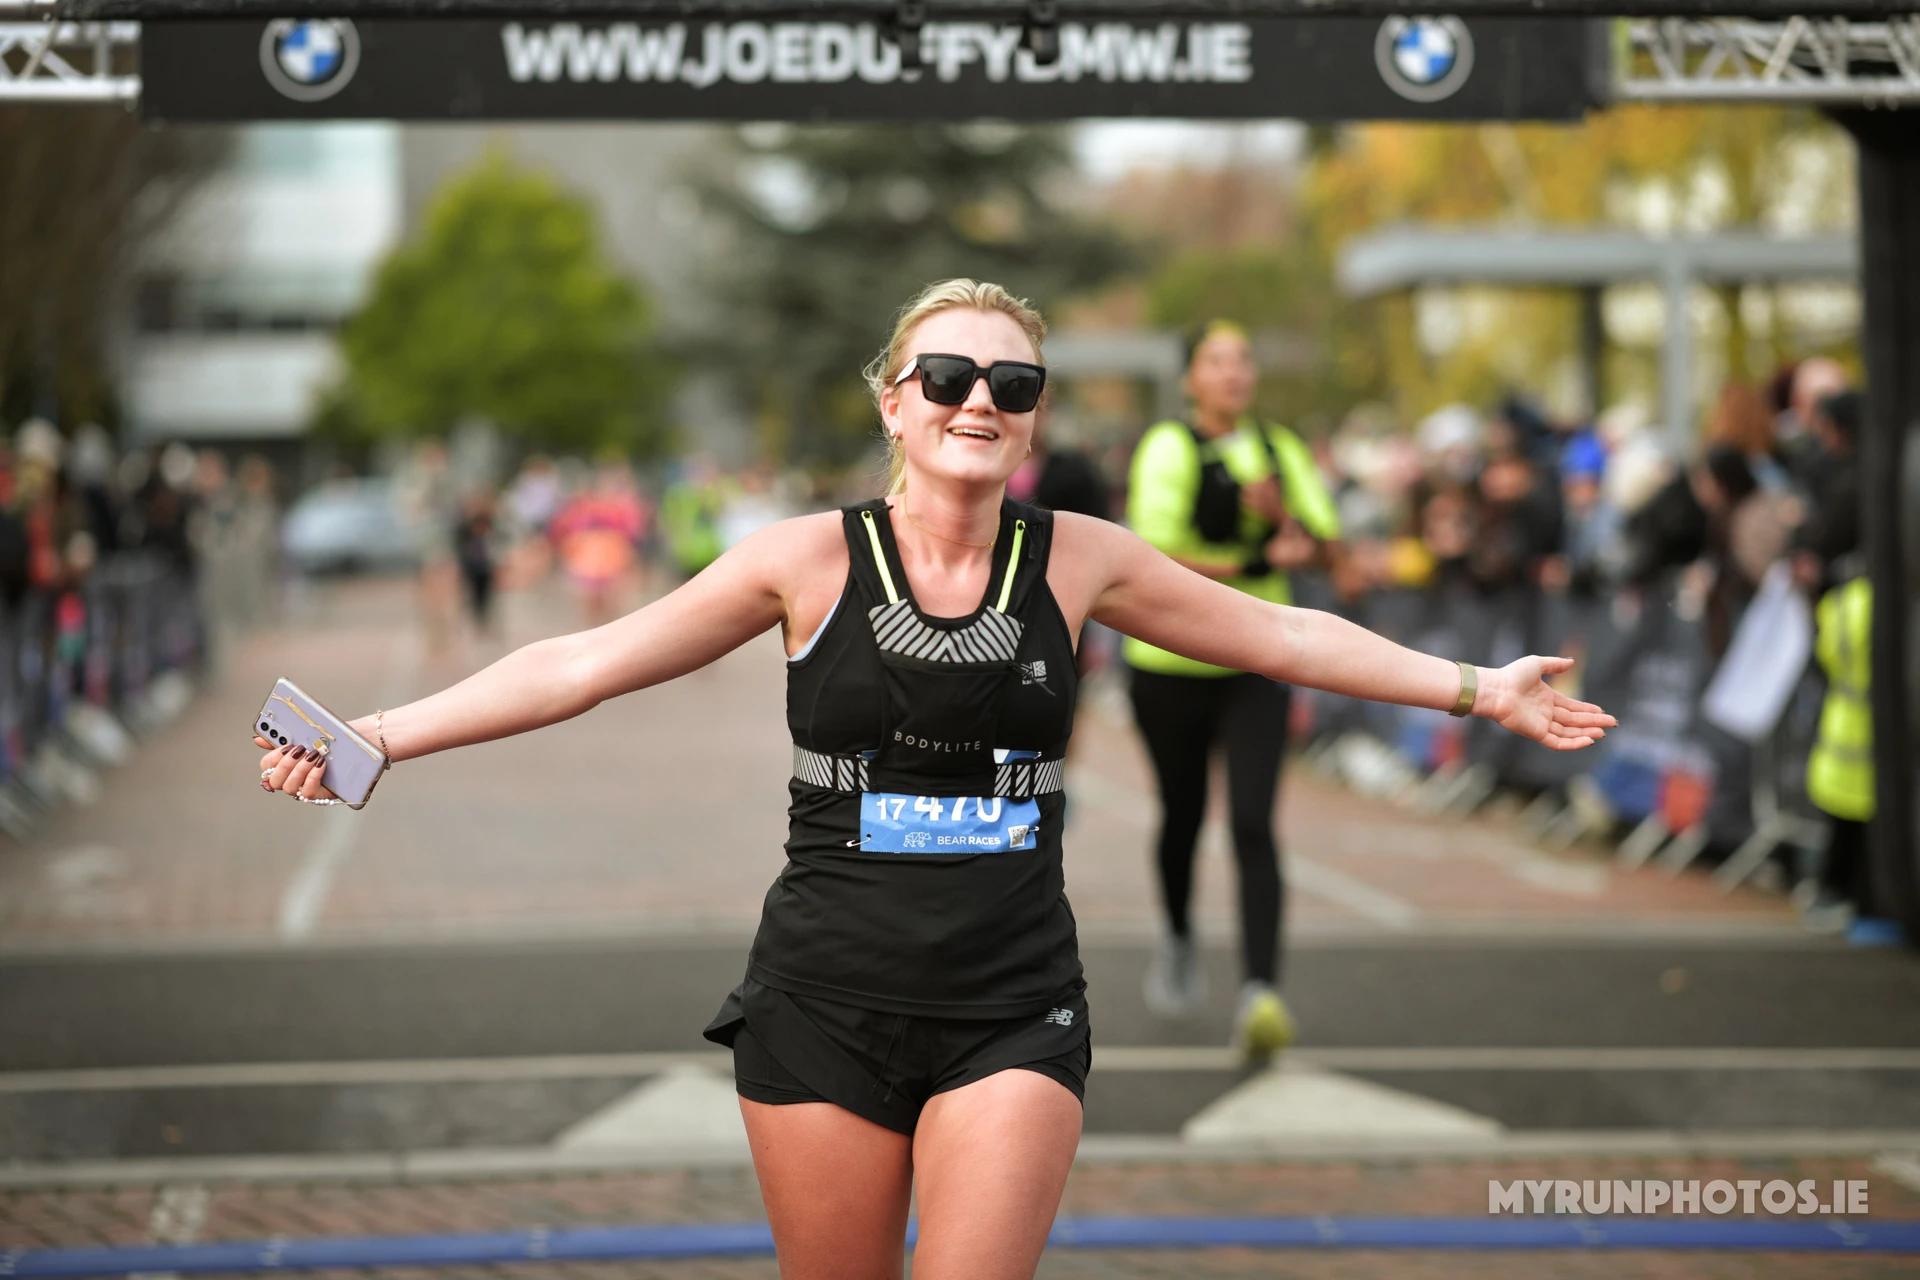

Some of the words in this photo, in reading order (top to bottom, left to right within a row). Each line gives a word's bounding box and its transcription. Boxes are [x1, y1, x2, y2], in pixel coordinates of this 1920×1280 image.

[894, 731, 981, 752] BODYLITE
[937, 836, 967, 845] BEAR
[968, 836, 1001, 845] RACES
